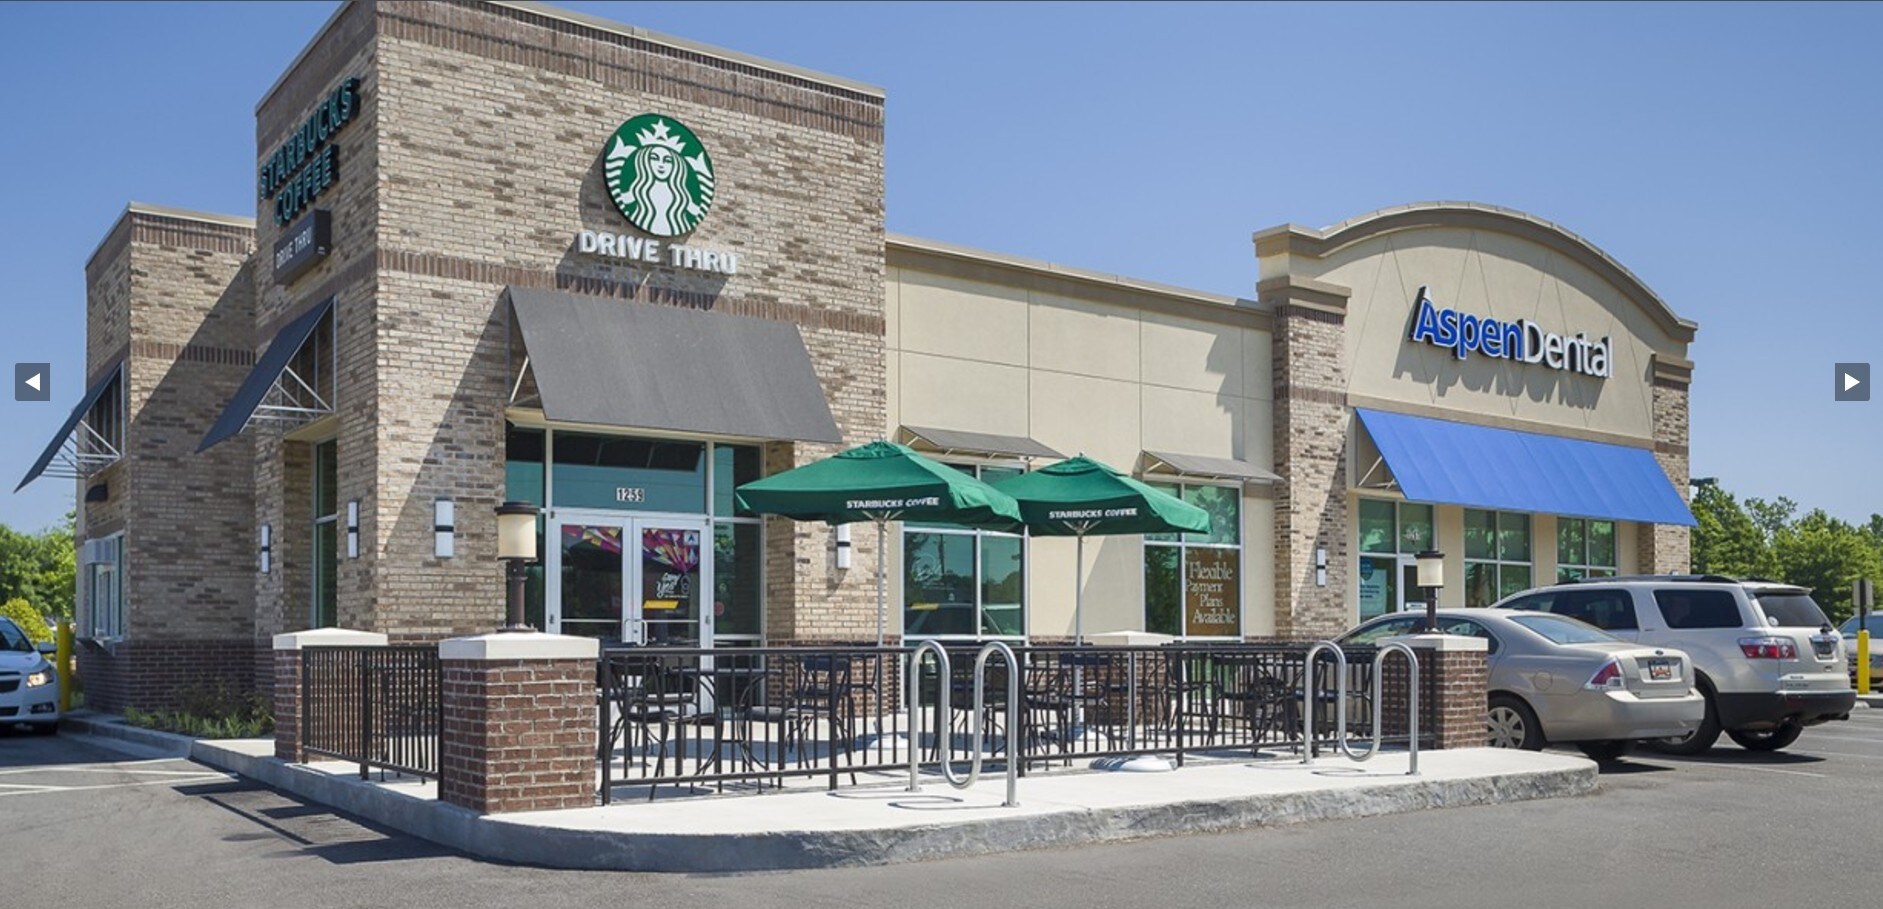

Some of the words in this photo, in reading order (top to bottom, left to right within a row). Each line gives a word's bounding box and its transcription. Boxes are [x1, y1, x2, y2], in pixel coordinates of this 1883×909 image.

[260, 77, 359, 200] STARBUCKS
[273, 145, 334, 227] COFFEE
[276, 241, 293, 269] DRIVE
[295, 226, 312, 254] THRU
[578, 229, 661, 263] DRIVE
[668, 243, 738, 275] THRU
[617, 488, 645, 502] 1259
[846, 499, 903, 509] STARBUCKS
[1049, 509, 1103, 519] STARBUCKS
[1104, 507, 1138, 517] COFFEE
[1189, 561, 1233, 580] Flexible
[1186, 580, 1224, 596] Payment
[1200, 593, 1224, 607] Plans
[1192, 608, 1236, 625] Available
